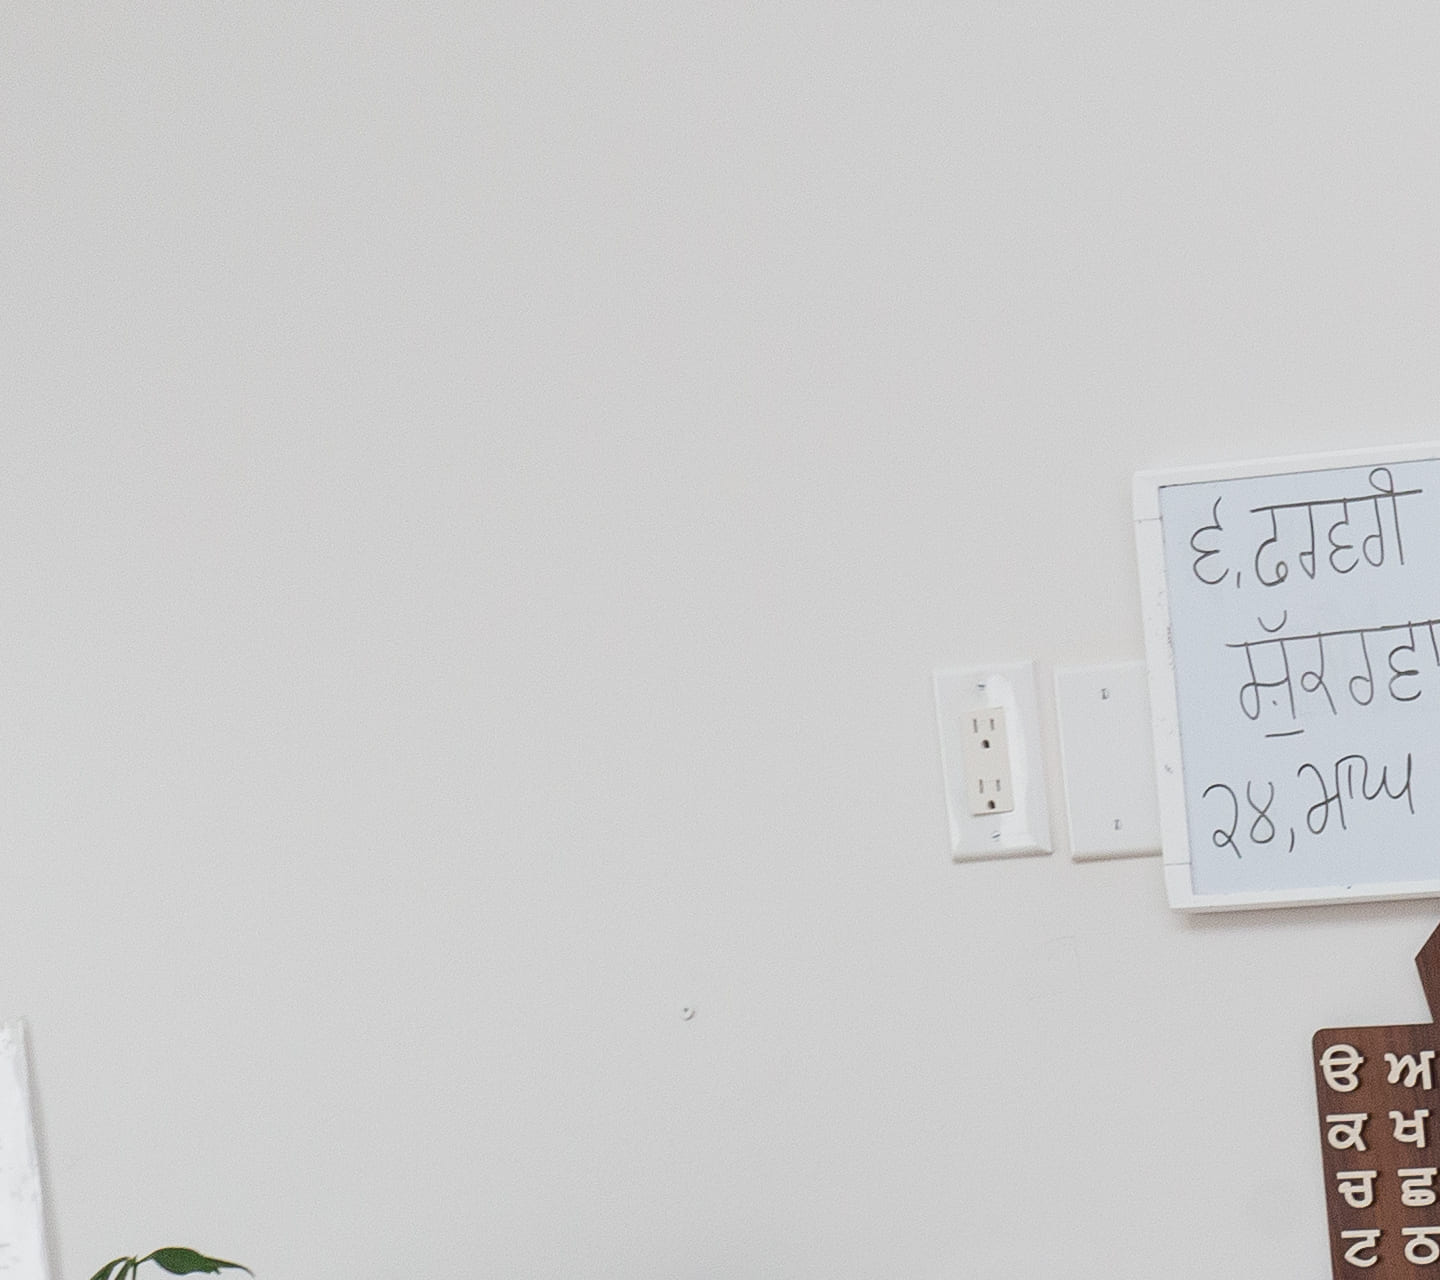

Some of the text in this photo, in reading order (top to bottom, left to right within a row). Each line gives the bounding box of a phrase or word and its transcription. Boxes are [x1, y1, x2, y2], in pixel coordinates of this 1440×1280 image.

[1383, 1050, 1435, 1090] ਅ
[1325, 1112, 1368, 1152] ਕ
[1388, 1109, 1429, 1148] ਖ
[1336, 1170, 1377, 1208] ਚ
[1397, 1167, 1437, 1207] ਛ
[1340, 1229, 1381, 1268] ਟ
